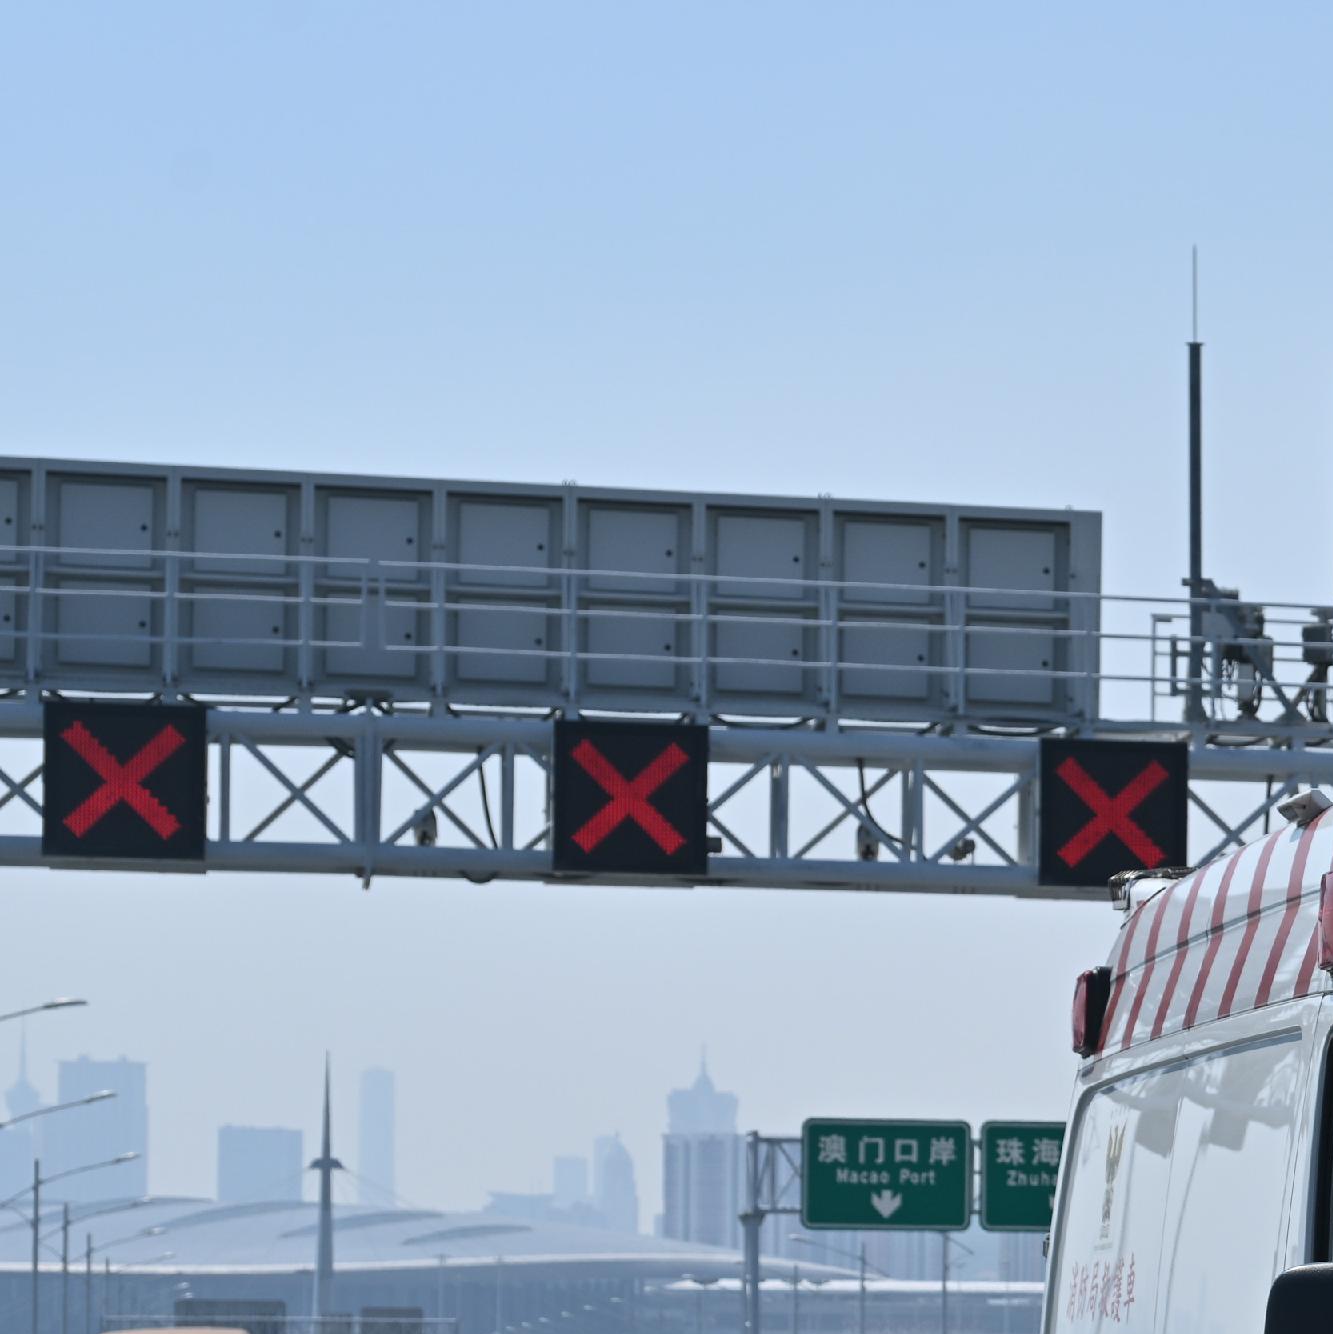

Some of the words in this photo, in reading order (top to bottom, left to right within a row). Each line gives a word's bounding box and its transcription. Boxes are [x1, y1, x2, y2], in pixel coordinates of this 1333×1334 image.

[817, 1133, 957, 1165] 澳门口岸
[995, 1136, 1061, 1166] 珠海
[836, 1168, 891, 1185] Macao
[899, 1168, 937, 1185] Port
